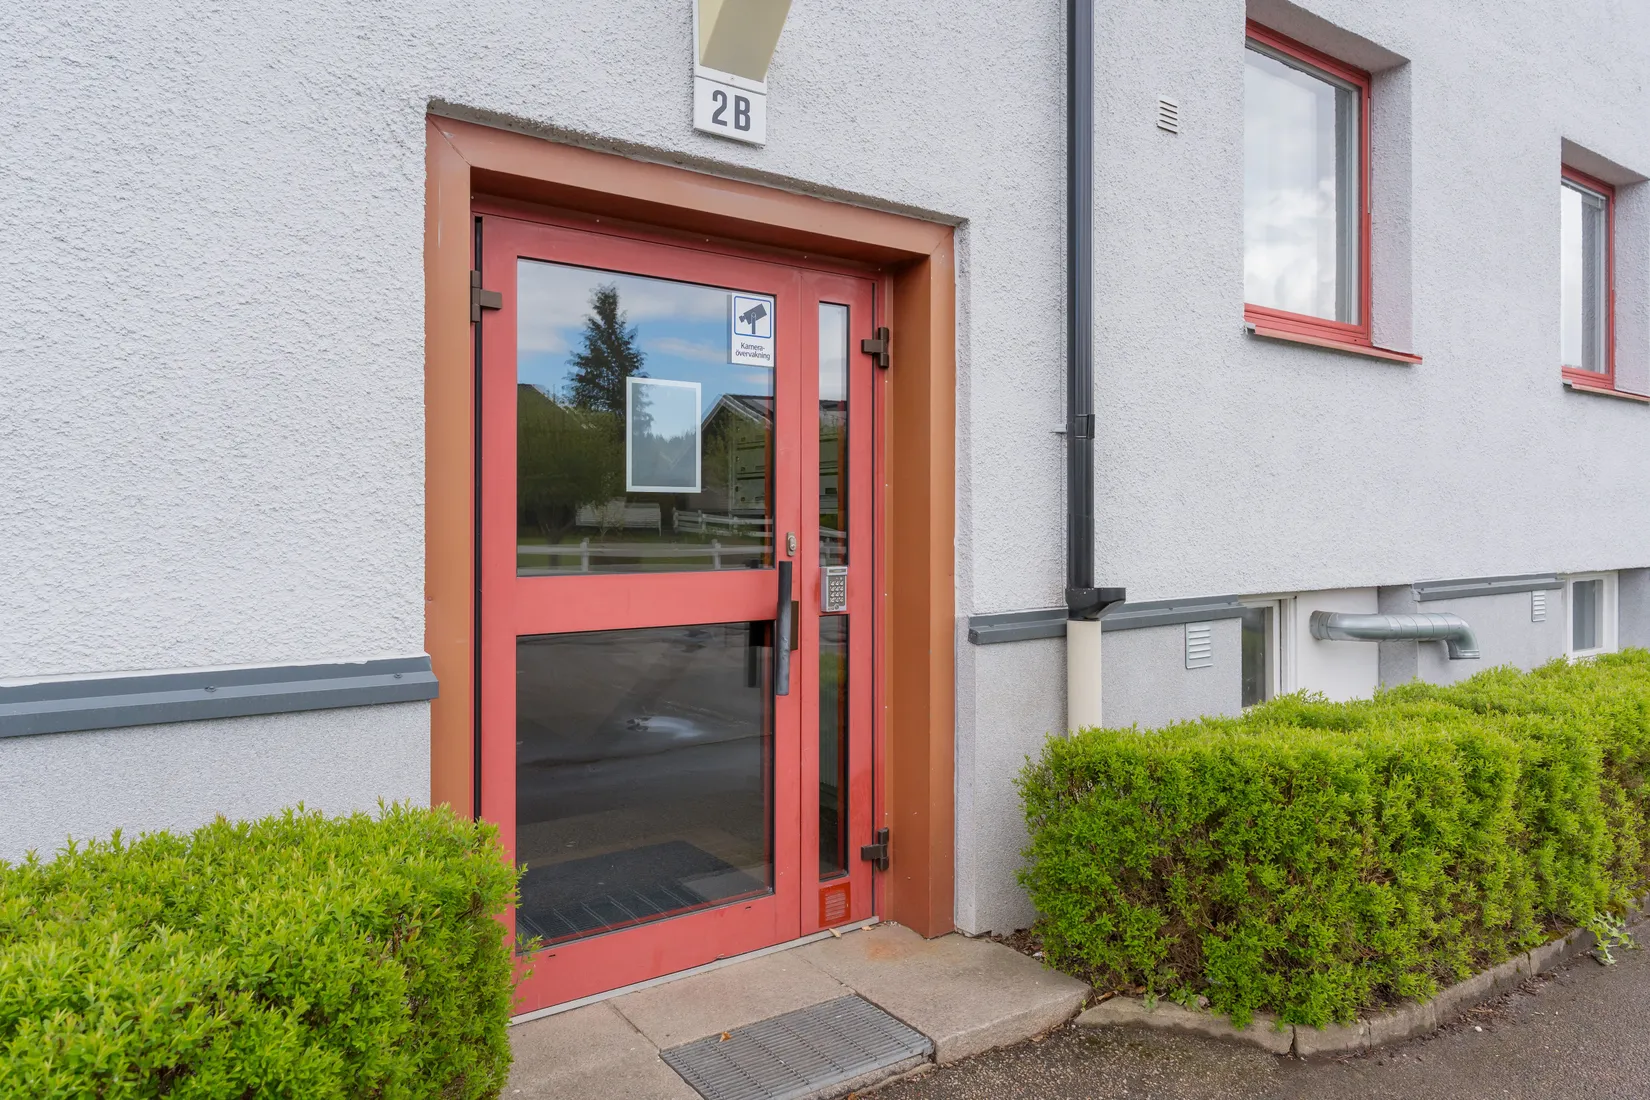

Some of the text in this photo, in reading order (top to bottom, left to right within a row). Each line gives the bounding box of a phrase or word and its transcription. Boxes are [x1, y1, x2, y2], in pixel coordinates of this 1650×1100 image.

[712, 90, 750, 131] 2B
[740, 342, 765, 351] Kamera-
[735, 349, 770, 361] övervakning
